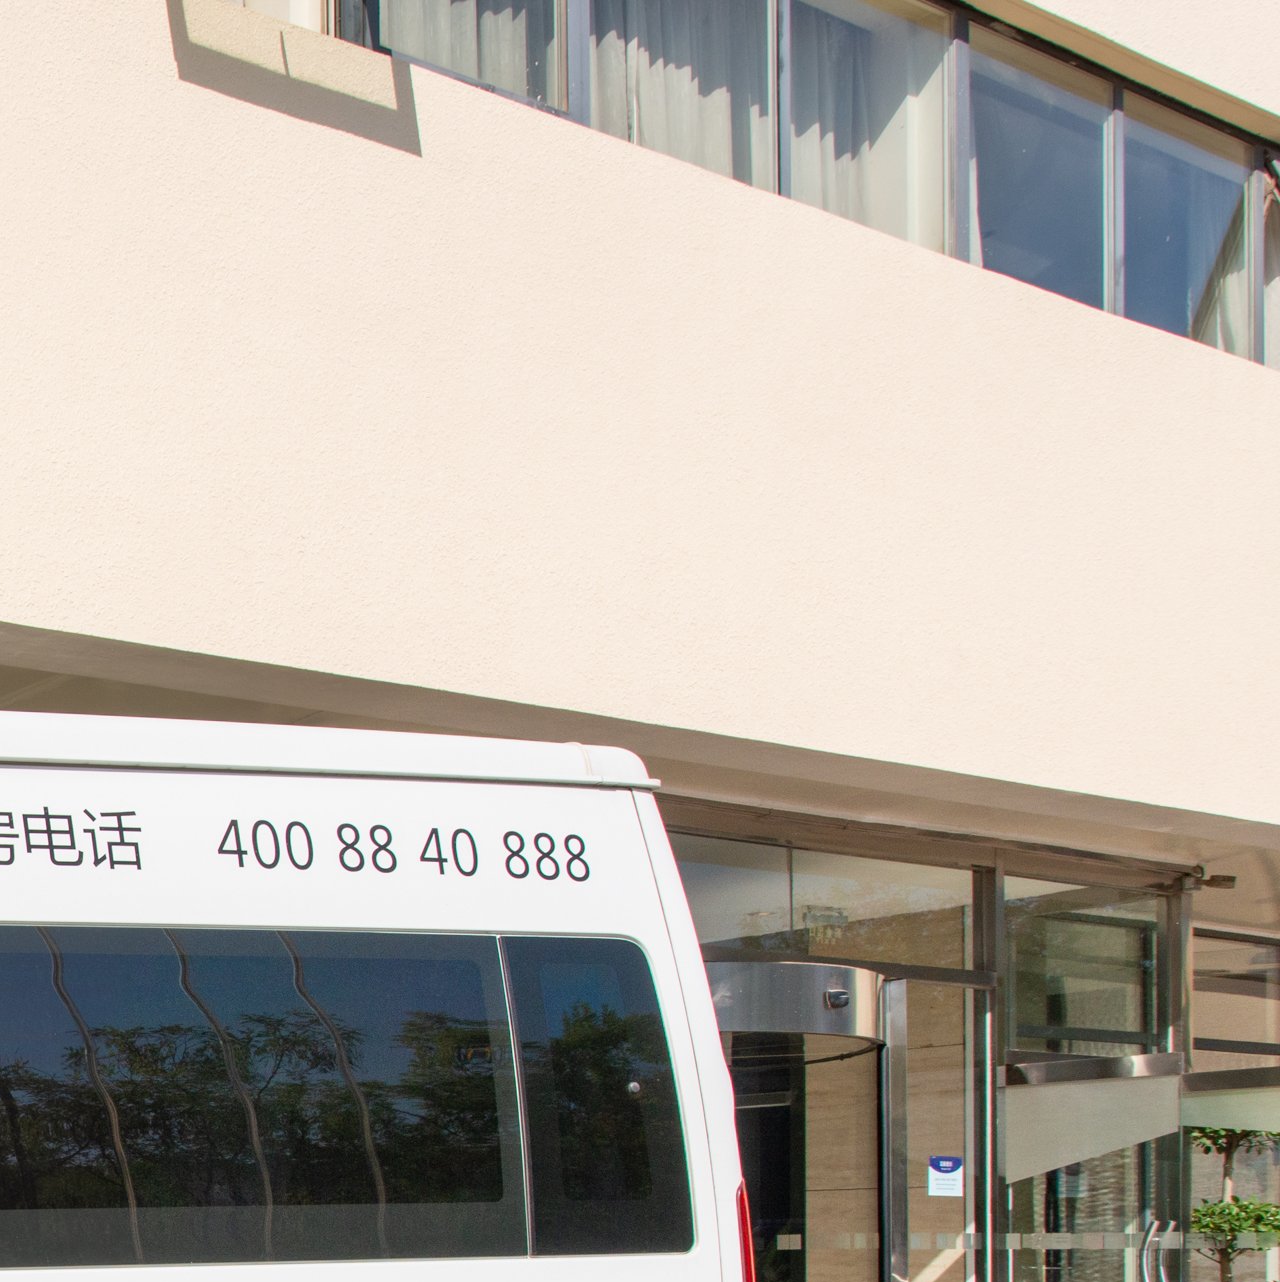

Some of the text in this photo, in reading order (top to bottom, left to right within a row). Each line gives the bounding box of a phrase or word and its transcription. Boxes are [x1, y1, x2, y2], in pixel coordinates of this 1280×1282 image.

[217, 819, 315, 871] 400
[336, 823, 399, 874] 88
[419, 827, 479, 877] 40
[502, 830, 591, 882] 888
